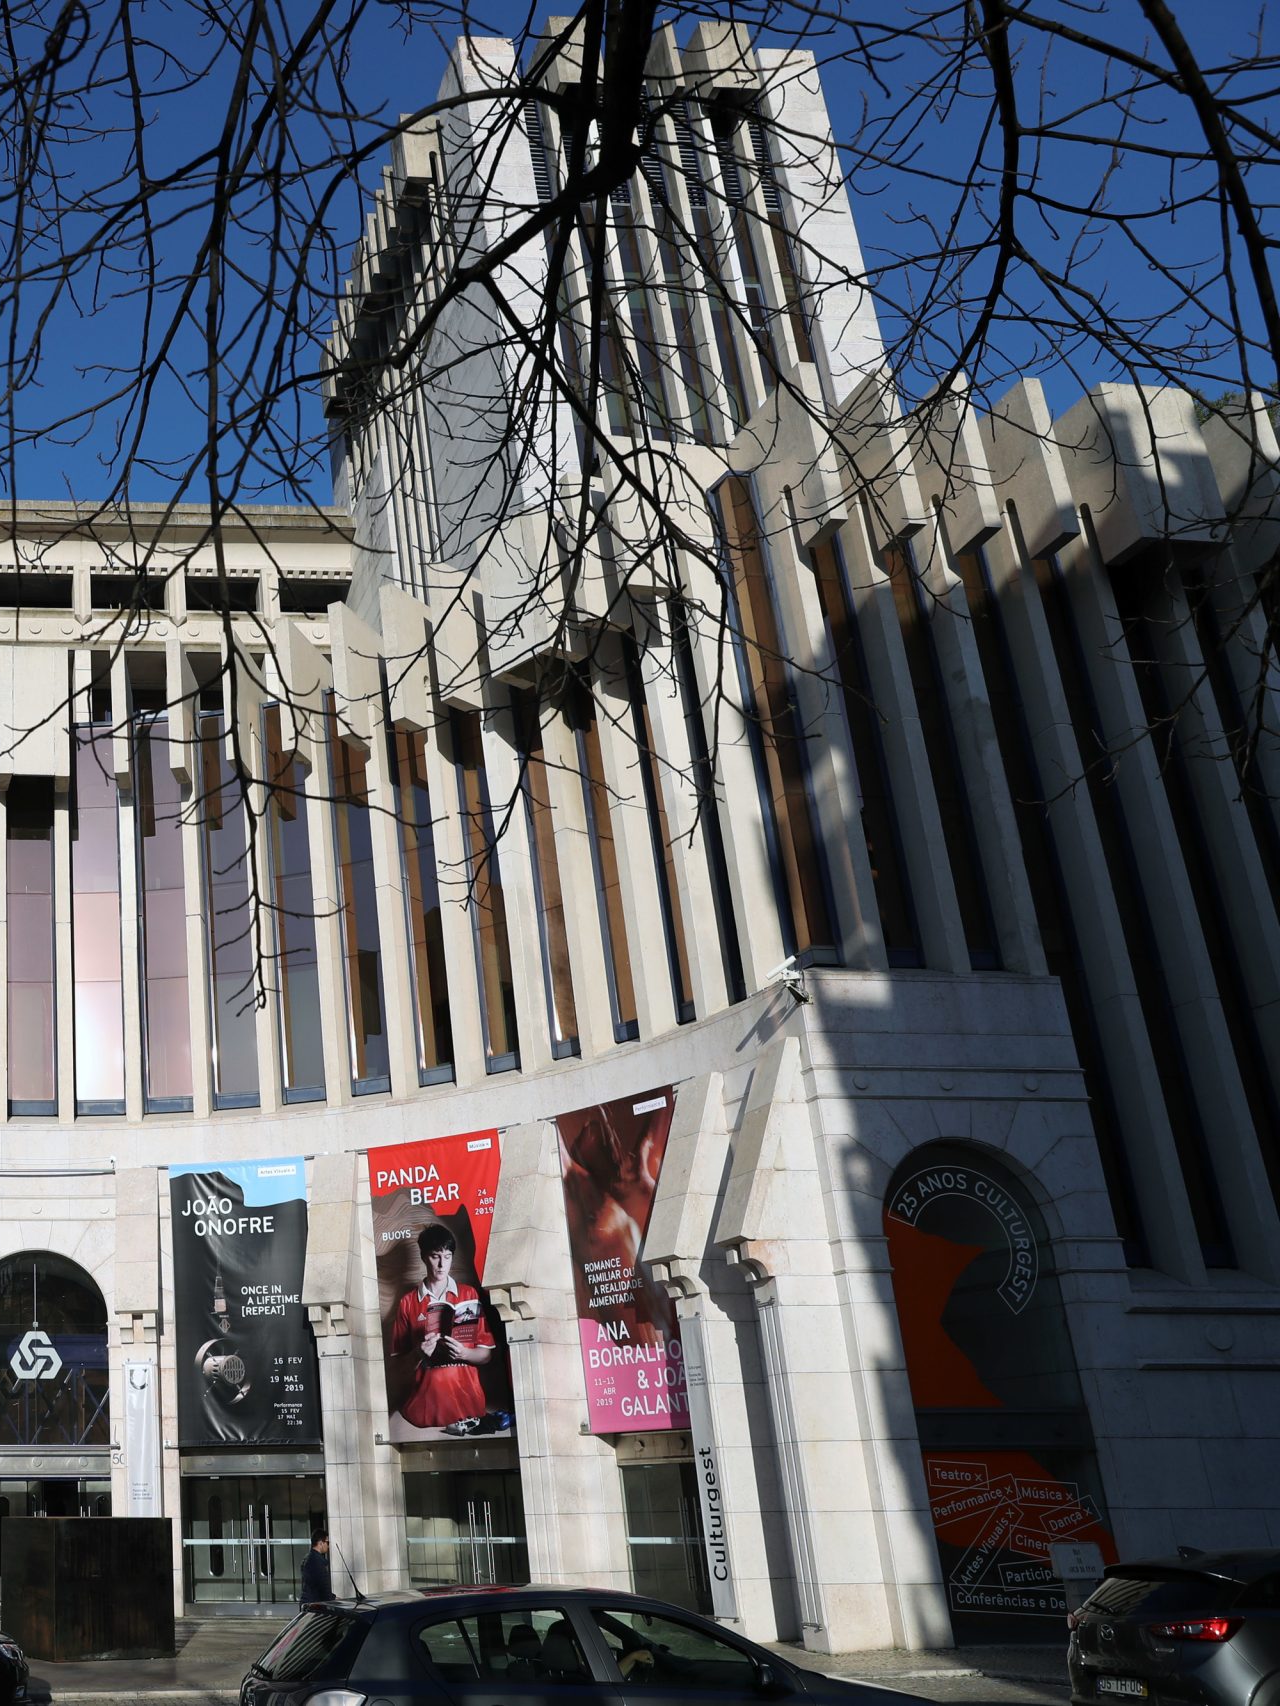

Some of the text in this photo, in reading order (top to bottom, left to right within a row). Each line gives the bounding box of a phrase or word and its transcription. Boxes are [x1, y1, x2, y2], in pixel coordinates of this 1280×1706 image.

[377, 1164, 440, 1188] PANDA
[410, 1183, 460, 1206] BEAR
[477, 1188, 487, 1197] 24
[181, 1195, 232, 1216] JOÃO
[480, 1197, 494, 1206] ABR
[475, 1206, 494, 1215] 2019
[194, 1216, 275, 1236] ONOFRE
[382, 1229, 411, 1241] BUOYS
[897, 1172, 1032, 1302] 25 ANOS CULTURGEST
[584, 1257, 622, 1273] ROMANCE
[588, 1267, 635, 1285] FAMILIAR OU
[241, 1285, 282, 1295] ONCE IN
[600, 1278, 644, 1294] REALIDADE
[247, 1294, 300, 1305] A LIFETIME
[589, 1294, 636, 1308] AUMENTADA
[241, 1304, 286, 1317] [REPEAT]
[597, 1320, 630, 1343] ANA
[273, 1356, 303, 1365] 16 FEV
[590, 1340, 681, 1368] BORRALHO
[270, 1375, 280, 1383] 19
[637, 1369, 650, 1389] &
[654, 1361, 686, 1388] JOÃ
[285, 1384, 304, 1392] 2019
[603, 1387, 616, 1396] ABR
[596, 1398, 613, 1406] 2019
[621, 1392, 690, 1417] GALANT
[934, 1467, 972, 1482] Teatro
[1021, 1487, 1063, 1500] Música
[933, 1487, 1004, 1519] Performance
[699, 1446, 728, 1581] Culturgest
[1049, 1510, 1083, 1531] Dança
[960, 1553, 984, 1585] Artes
[979, 1518, 1009, 1555] Visuais
[956, 1591, 1035, 1608] Conferências
[1039, 1600, 1047, 1608] e
